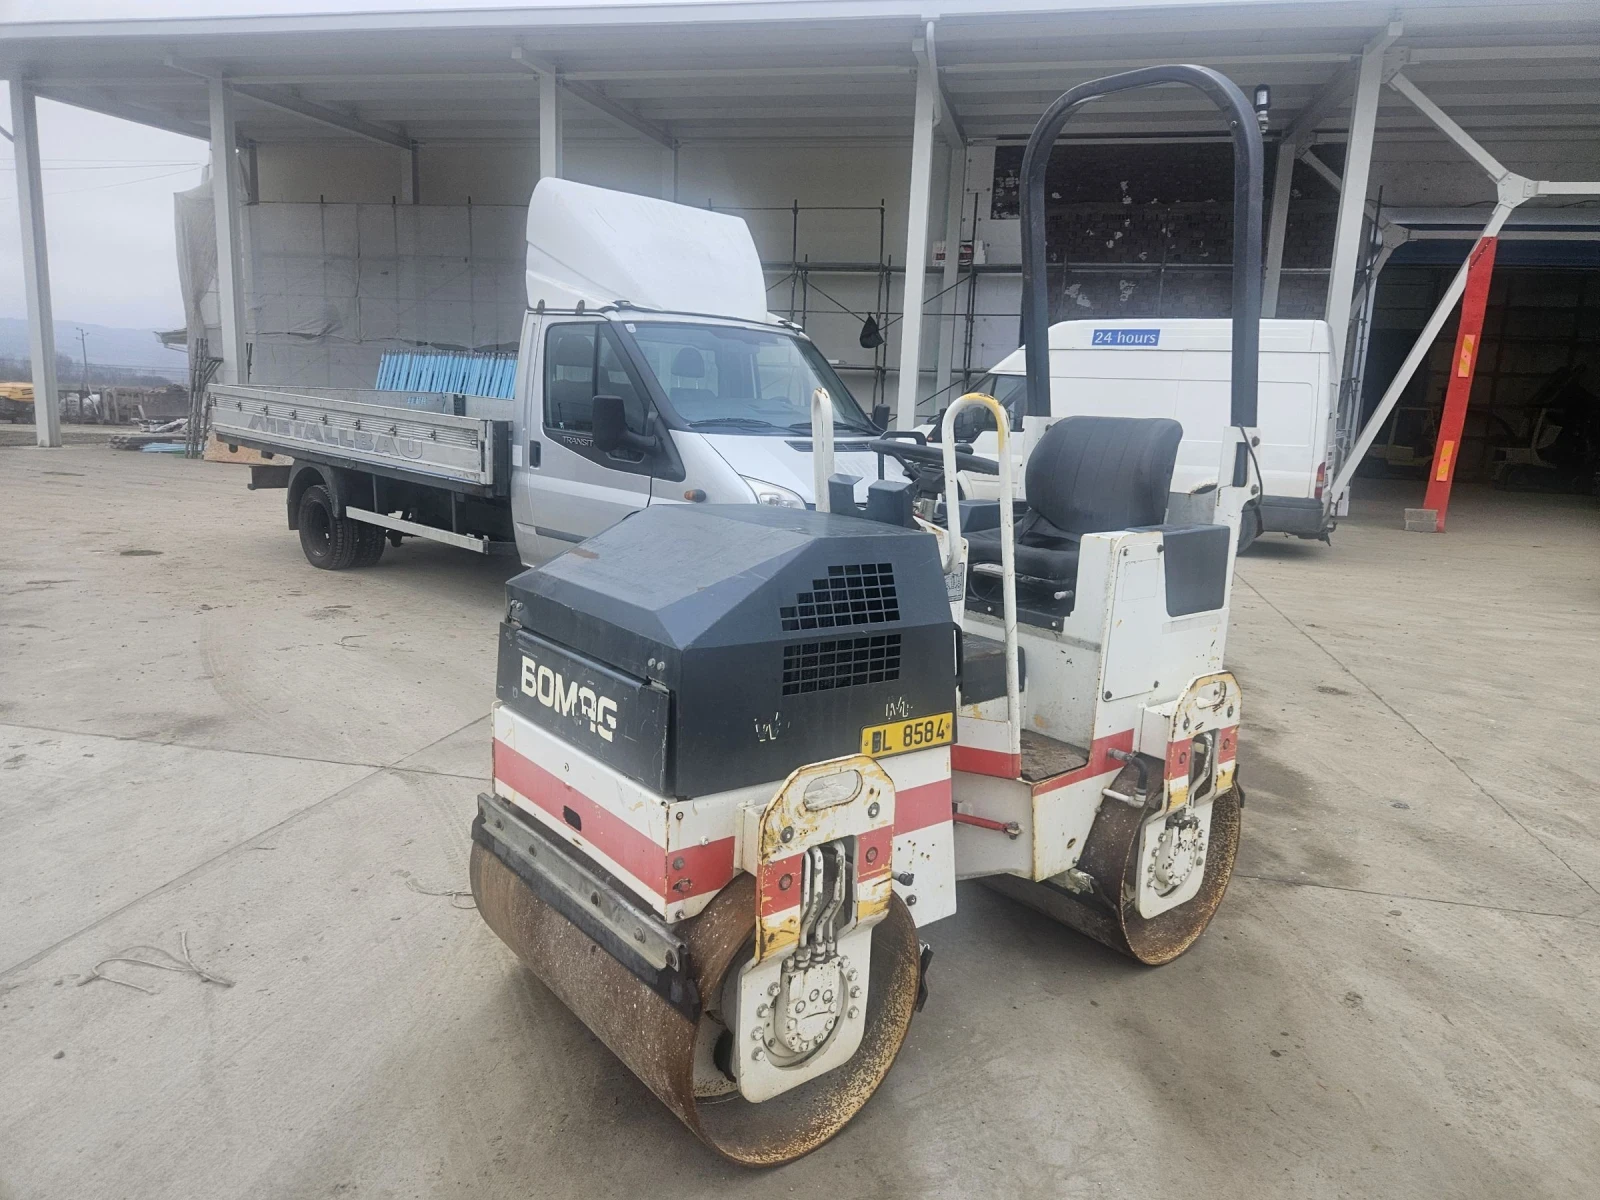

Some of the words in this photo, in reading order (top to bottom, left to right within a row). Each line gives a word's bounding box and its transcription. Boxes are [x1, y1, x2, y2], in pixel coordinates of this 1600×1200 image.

[1094, 332, 1113, 344] 24
[1117, 331, 1156, 344] hours
[248, 414, 423, 460] METALLBAU
[562, 436, 594, 447] TRANSIT
[521, 655, 617, 742] BOMAG
[903, 718, 945, 747] 8584
